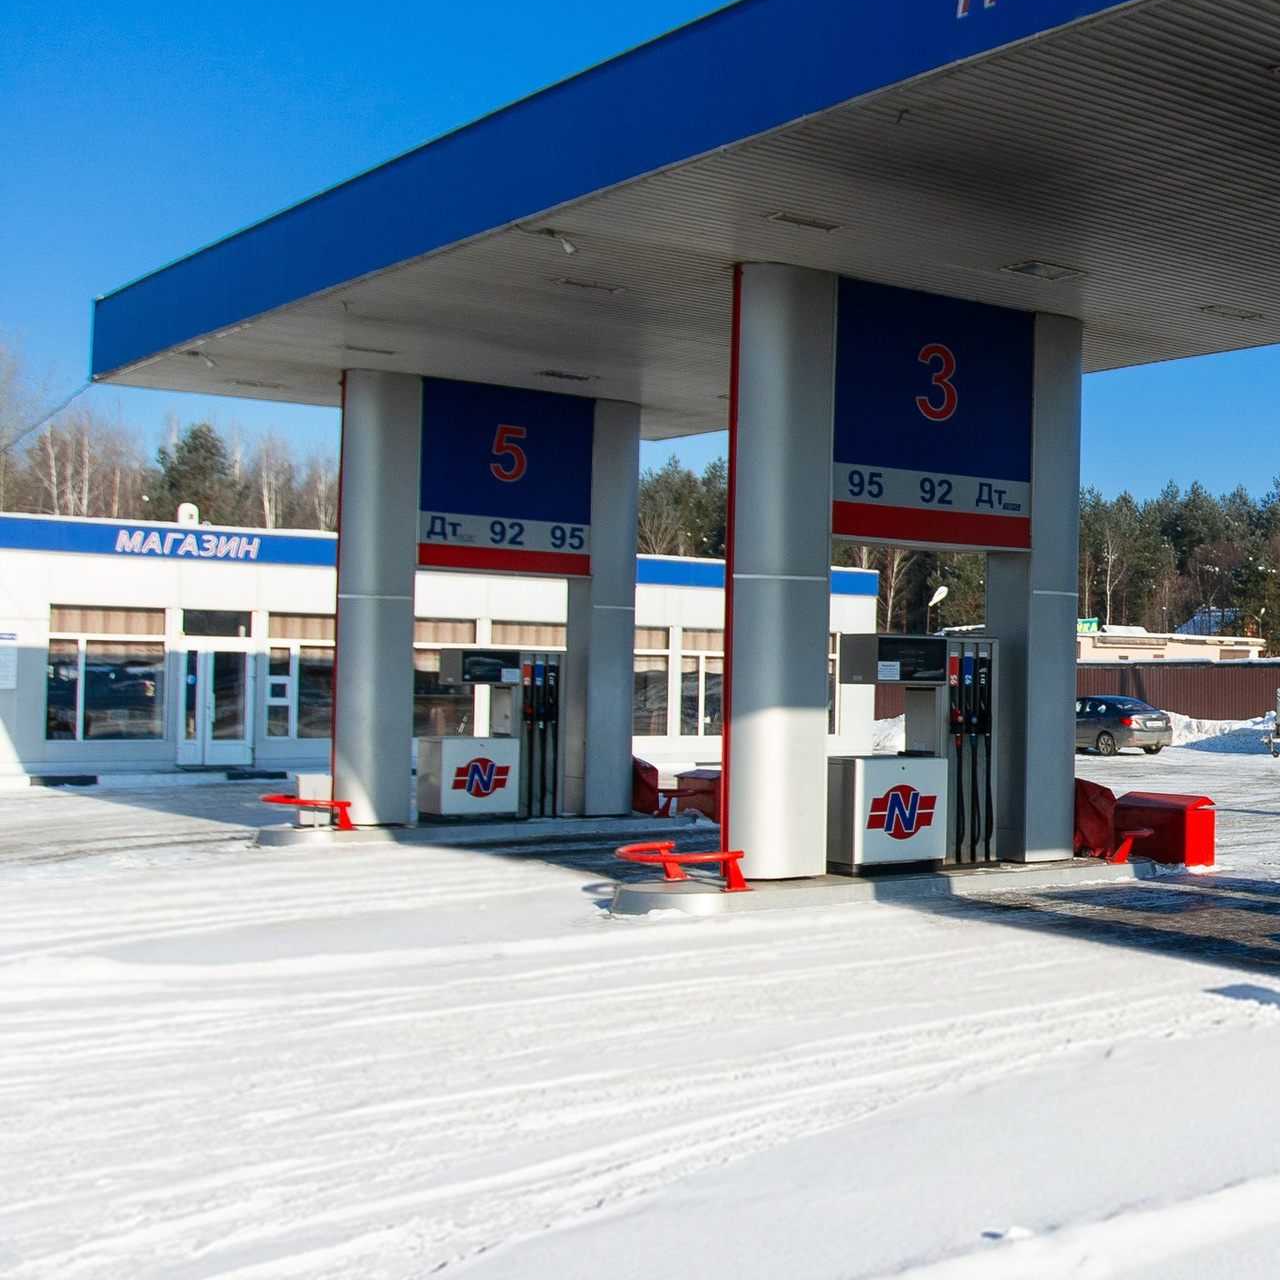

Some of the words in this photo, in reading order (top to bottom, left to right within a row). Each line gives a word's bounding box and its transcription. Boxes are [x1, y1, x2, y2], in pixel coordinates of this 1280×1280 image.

[915, 343, 958, 422] 3
[489, 424, 527, 482] 5
[848, 470, 884, 498] 95
[919, 477, 953, 505] 92
[975, 482, 1006, 509] Дт
[115, 529, 261, 560] МАГАЗИН
[489, 520, 524, 545] 92
[551, 525, 584, 550] 95
[950, 674, 958, 685] 95
[965, 674, 972, 685] 92
[466, 763, 496, 793] N
[884, 792, 920, 833] N
